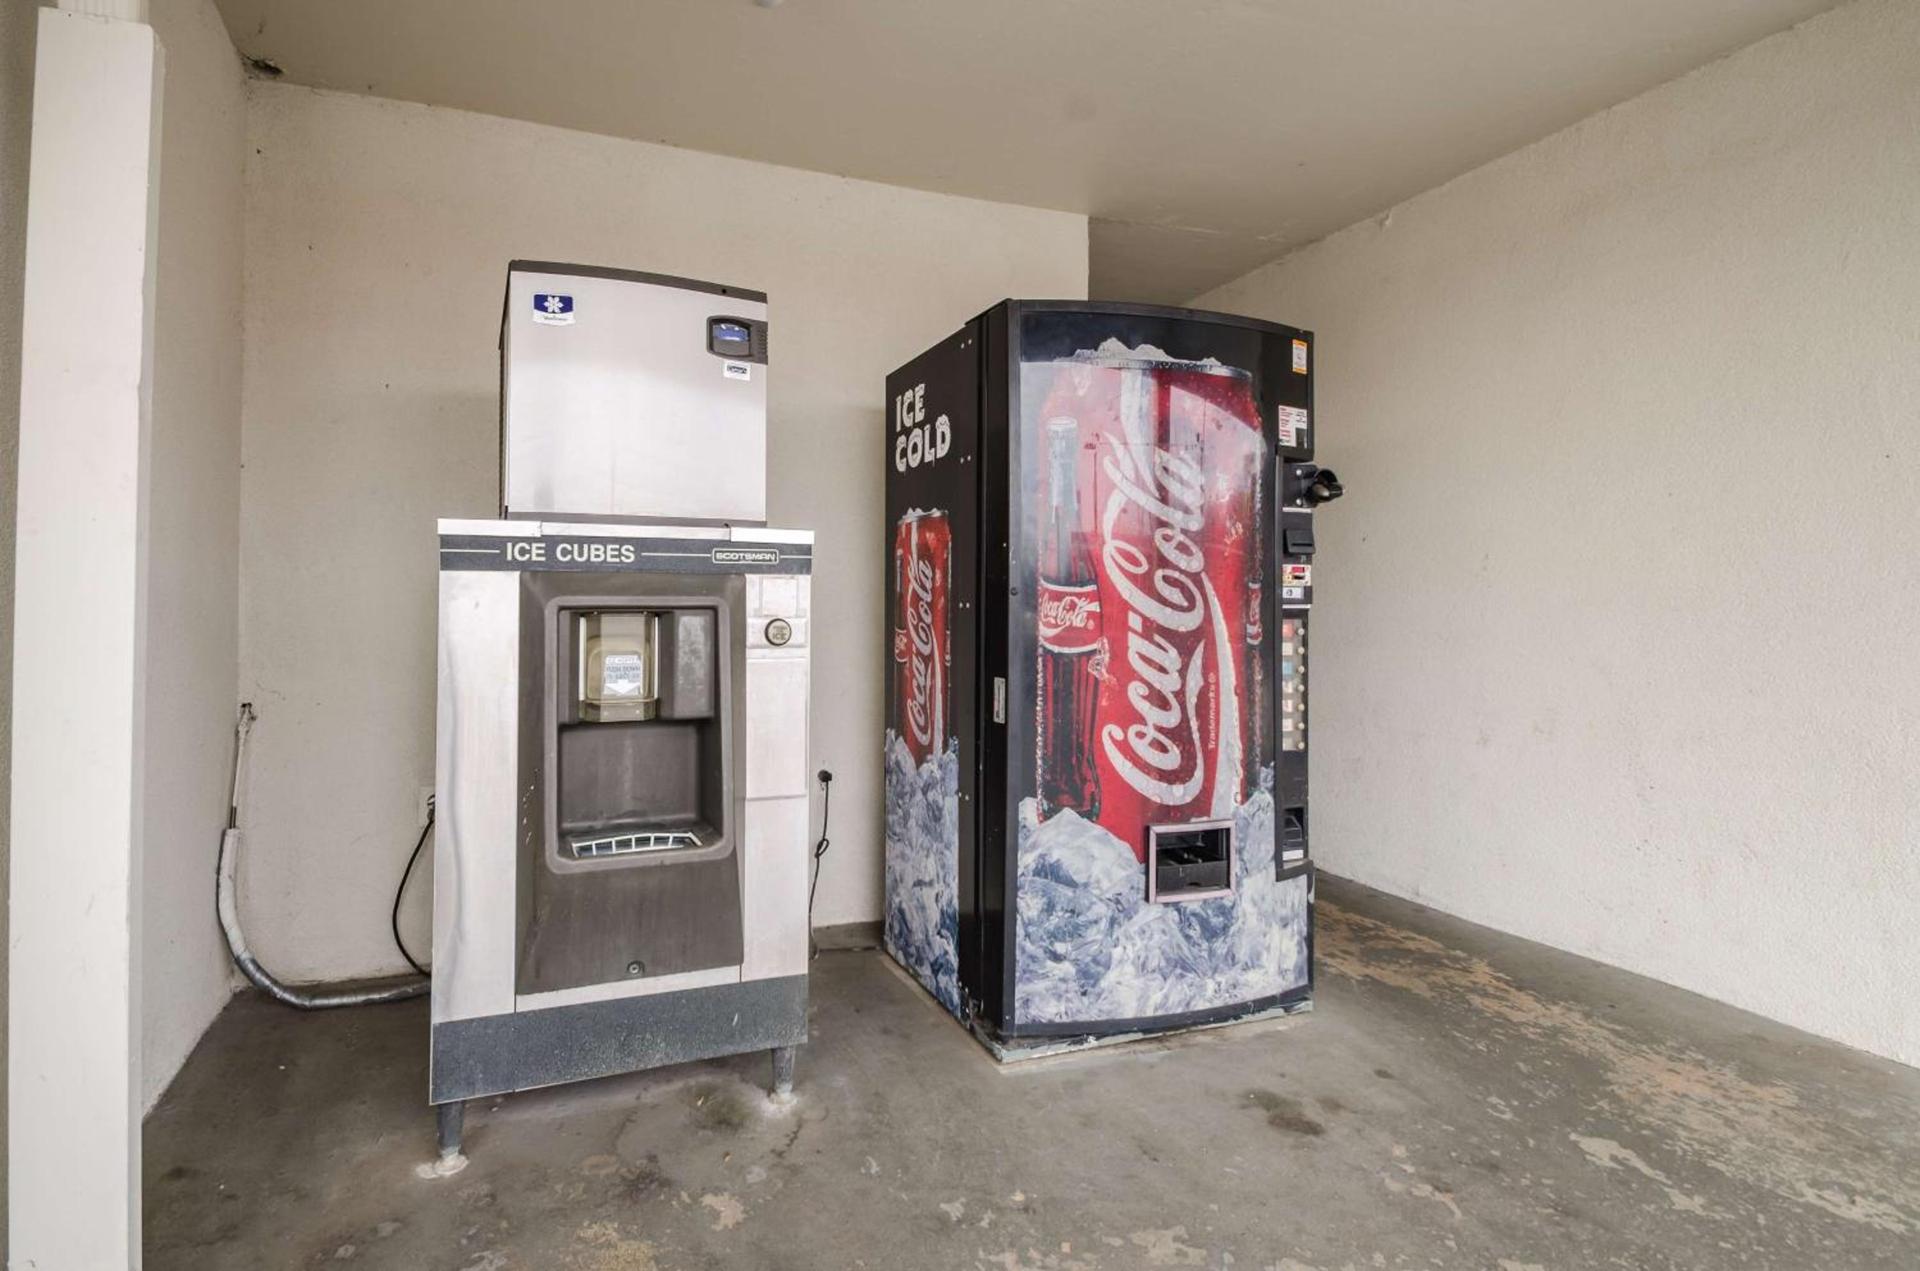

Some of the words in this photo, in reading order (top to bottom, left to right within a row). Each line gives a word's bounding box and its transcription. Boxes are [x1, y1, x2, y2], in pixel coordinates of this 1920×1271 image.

[895, 383, 926, 433] ICE
[895, 413, 952, 474] COLD
[506, 542, 546, 562] ICE
[555, 543, 636, 563] CUBES
[715, 552, 776, 561] SCOTSMAN
[1102, 430, 1205, 807] Coca-Cola
[907, 554, 934, 747] Coca-Cola
